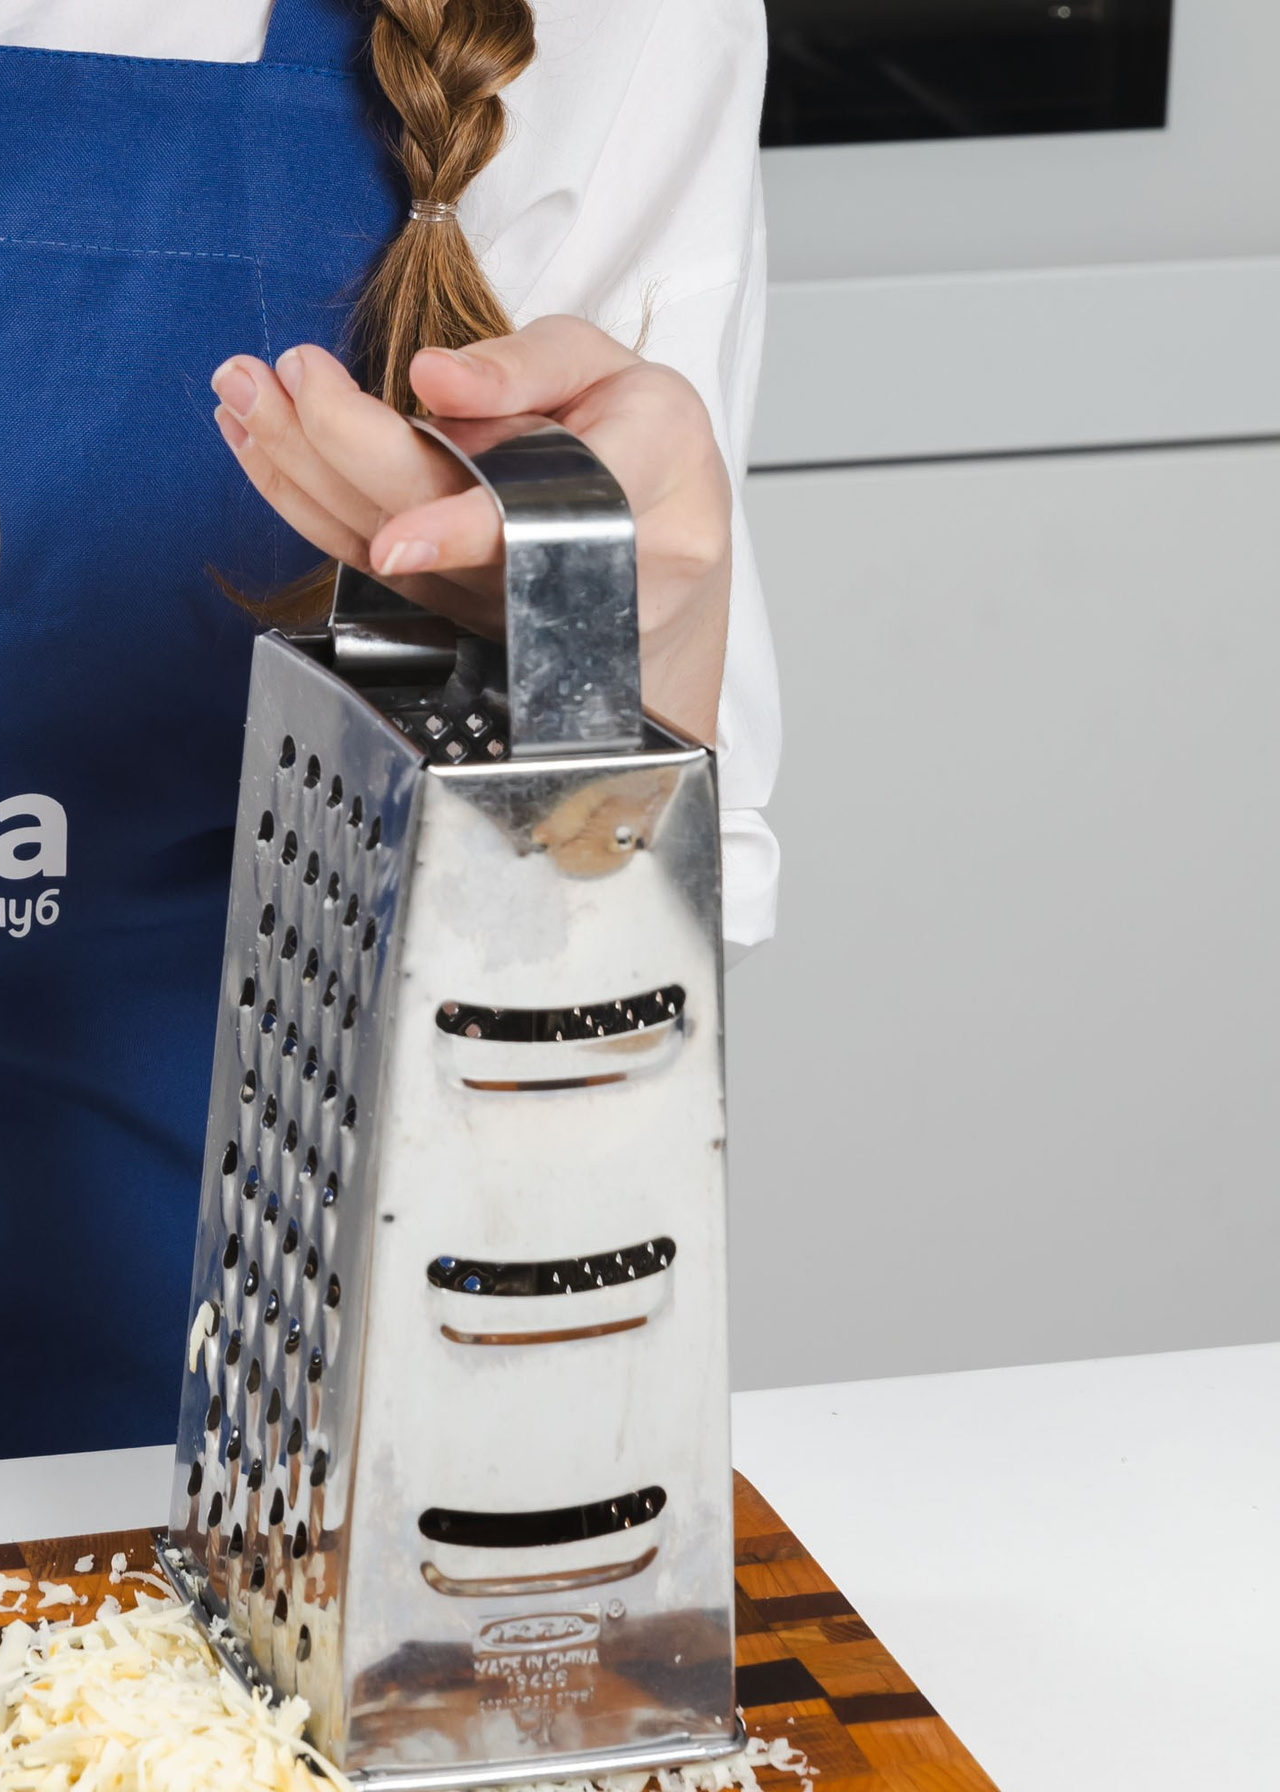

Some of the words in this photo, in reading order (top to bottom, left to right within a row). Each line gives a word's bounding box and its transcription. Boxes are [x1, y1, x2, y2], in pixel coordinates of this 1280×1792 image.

[473, 1654, 521, 1676] MADE
[525, 1653, 544, 1670] IN
[546, 1647, 599, 1672] CHINA
